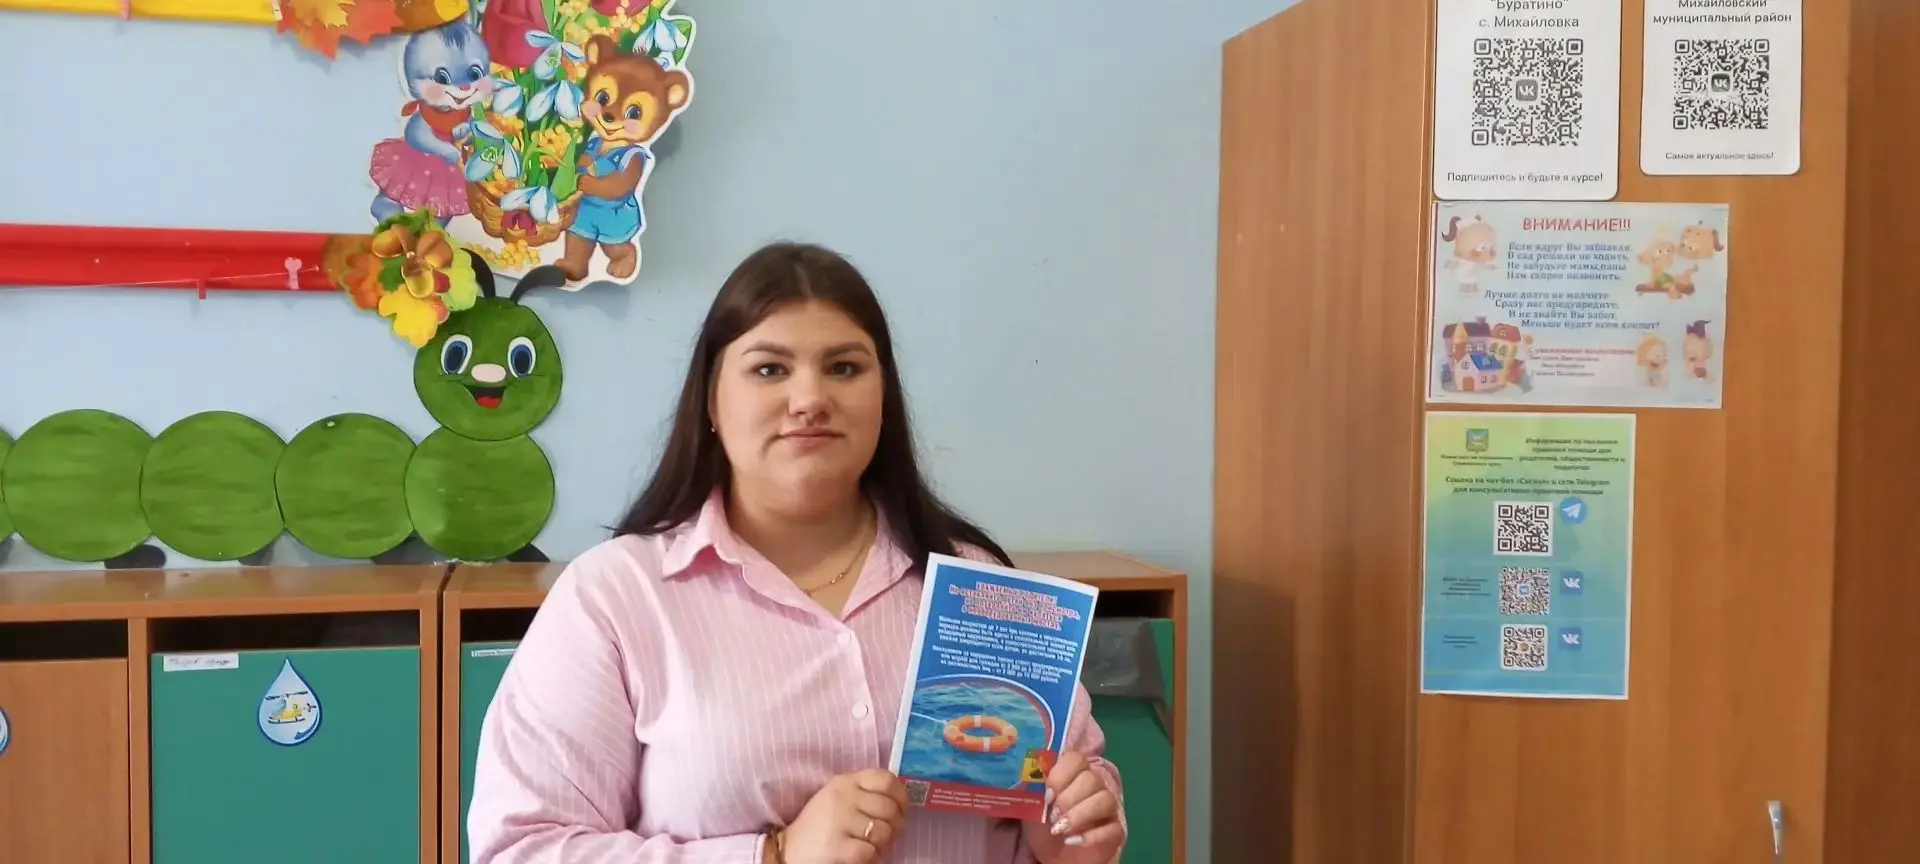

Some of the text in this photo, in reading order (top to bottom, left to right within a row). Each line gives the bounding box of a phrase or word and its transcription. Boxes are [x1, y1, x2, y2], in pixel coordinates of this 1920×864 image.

[1479, 15, 1580, 28] с. Михайловка
[1653, 12, 1792, 25] муниципальный район
[1665, 152, 1694, 160] Самое
[1447, 172, 1516, 183] Подпишитесь
[1528, 173, 1560, 183] будьте
[1571, 173, 1603, 183] курсе!
[1523, 218, 1631, 232] ВНИМАНИЕ!!!
[1508, 242, 1532, 251] Если
[1566, 243, 1581, 251] Вы
[1508, 252, 1514, 260] В
[1517, 253, 1534, 261] сад
[1536, 253, 1576, 262] решили
[1508, 262, 1520, 270] Не
[1522, 263, 1567, 272] забудьте
[1507, 272, 1527, 280] Нам
[1485, 290, 1517, 300] Лучше
[1520, 291, 1549, 300] долго
[1495, 300, 1524, 309] Сразу
[1508, 310, 1516, 318] И
[1570, 311, 1585, 319] Вы
[1522, 320, 1561, 328] Меньше
[1564, 321, 1592, 330] будет
